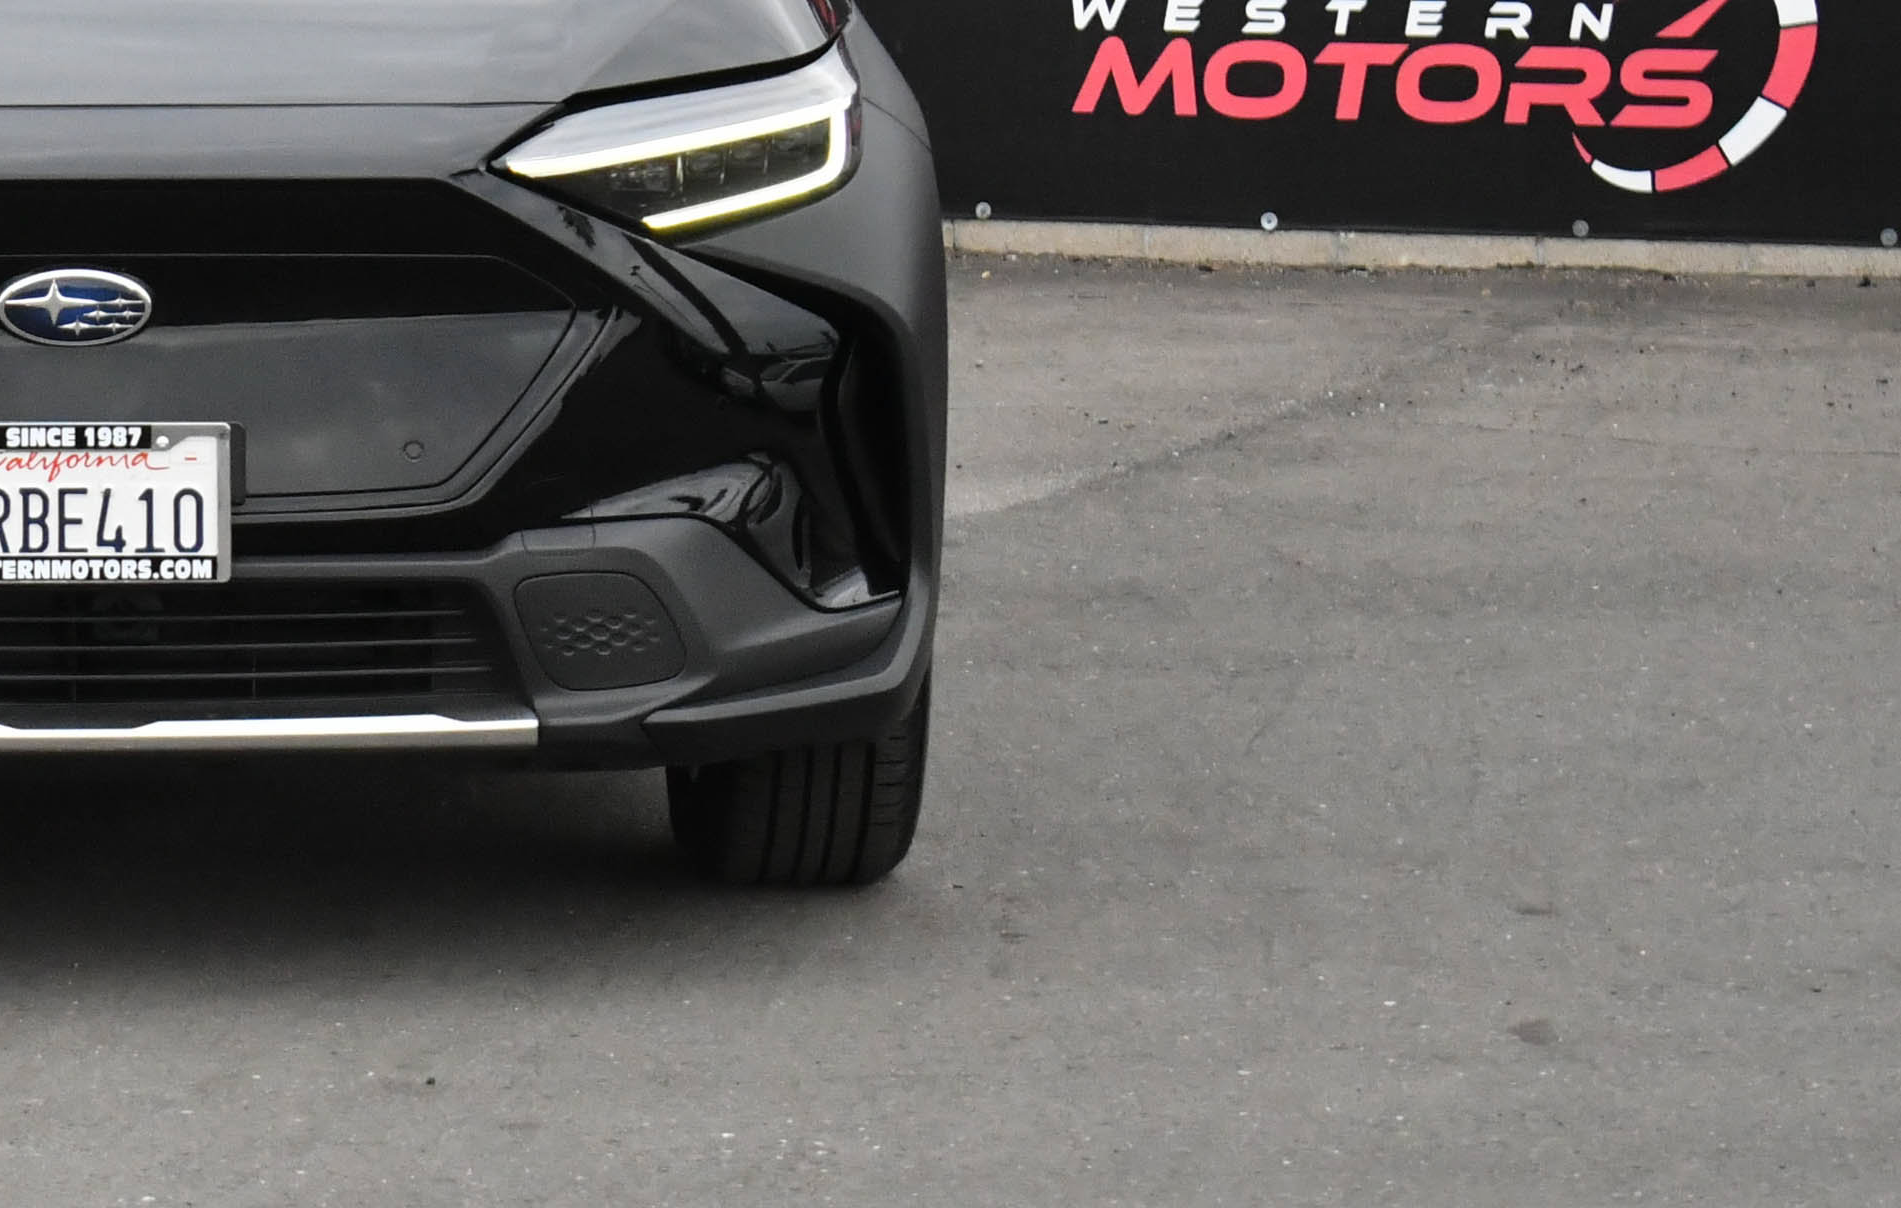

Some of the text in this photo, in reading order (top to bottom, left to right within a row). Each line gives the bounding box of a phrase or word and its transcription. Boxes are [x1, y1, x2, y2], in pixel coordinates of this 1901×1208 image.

[1072, 35, 1719, 129] MOTORS
[5, 426, 143, 449] SINCE 1987
